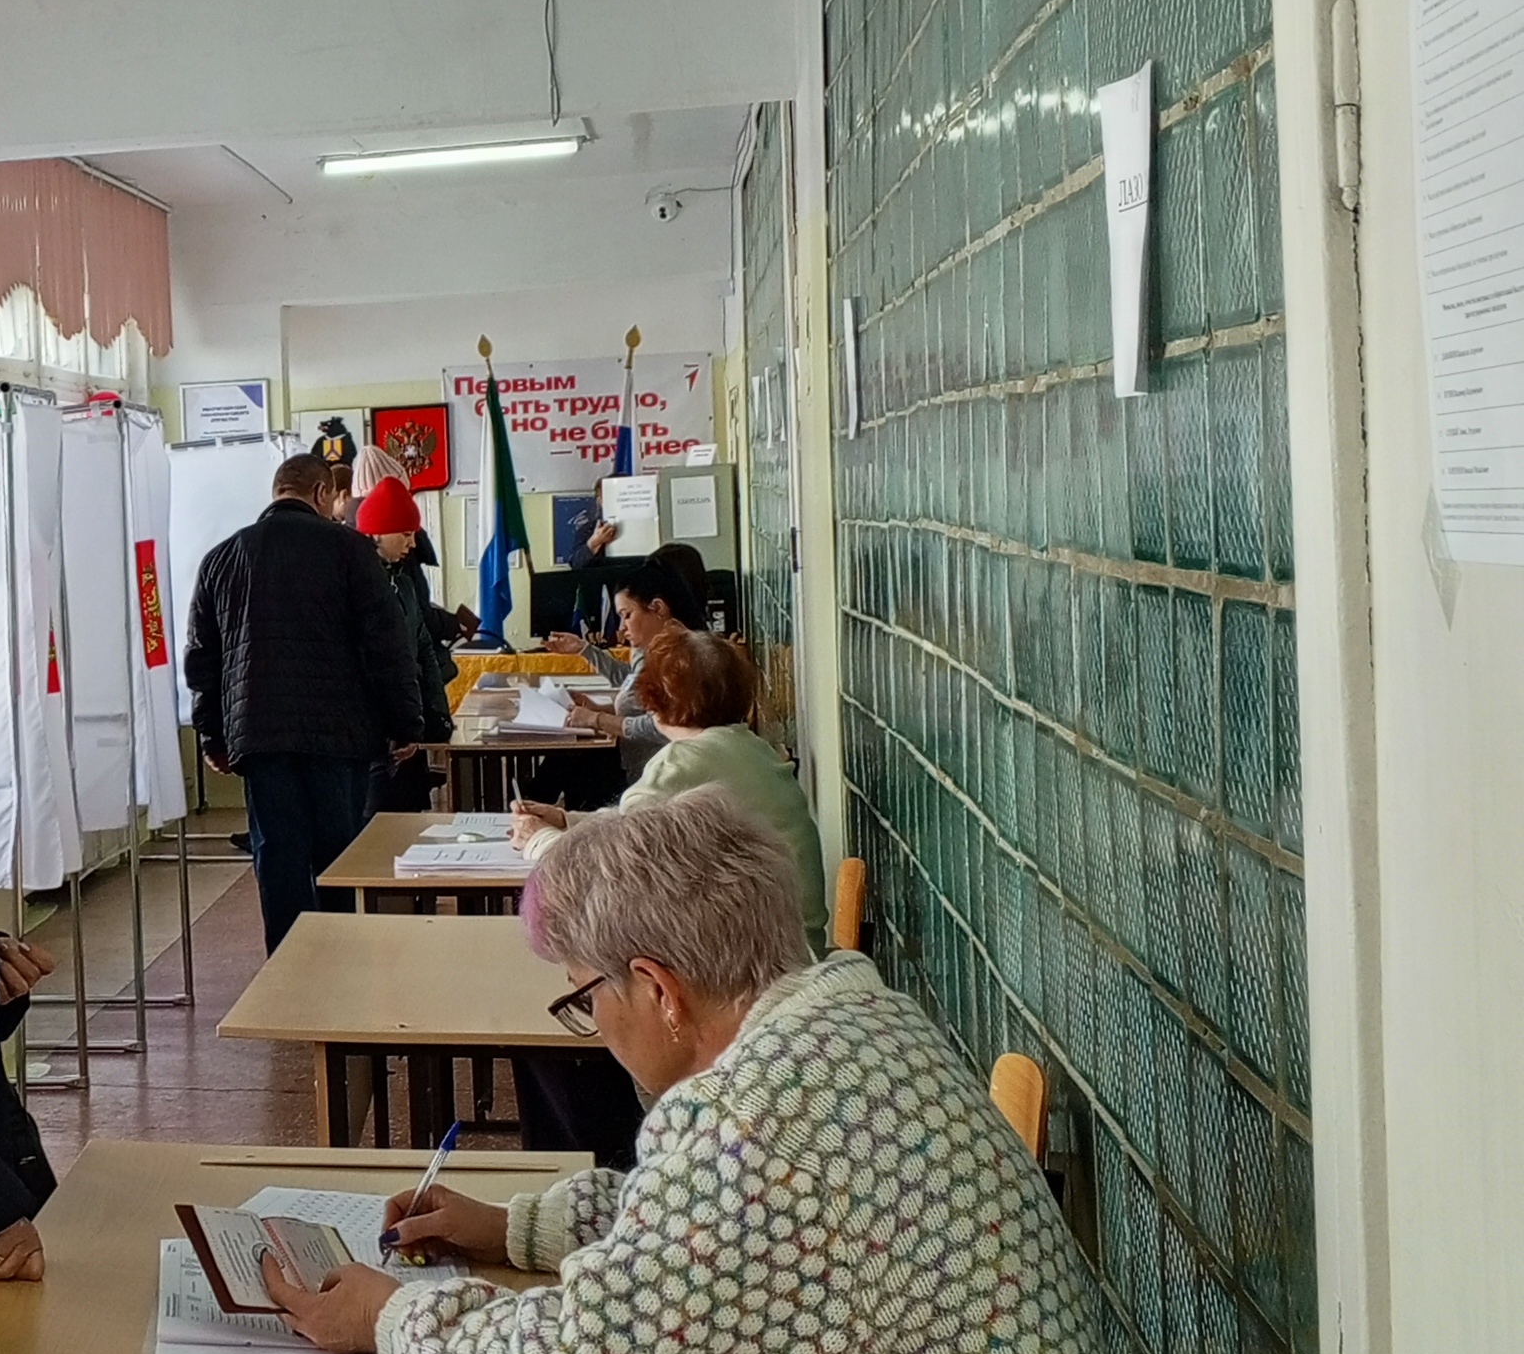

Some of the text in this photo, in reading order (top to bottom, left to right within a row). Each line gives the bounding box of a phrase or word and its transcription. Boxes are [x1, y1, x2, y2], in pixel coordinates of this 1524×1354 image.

[454, 374, 576, 396] Первым
[553, 392, 668, 416] трудо,
[511, 416, 548, 432] но
[550, 425, 586, 443] не
